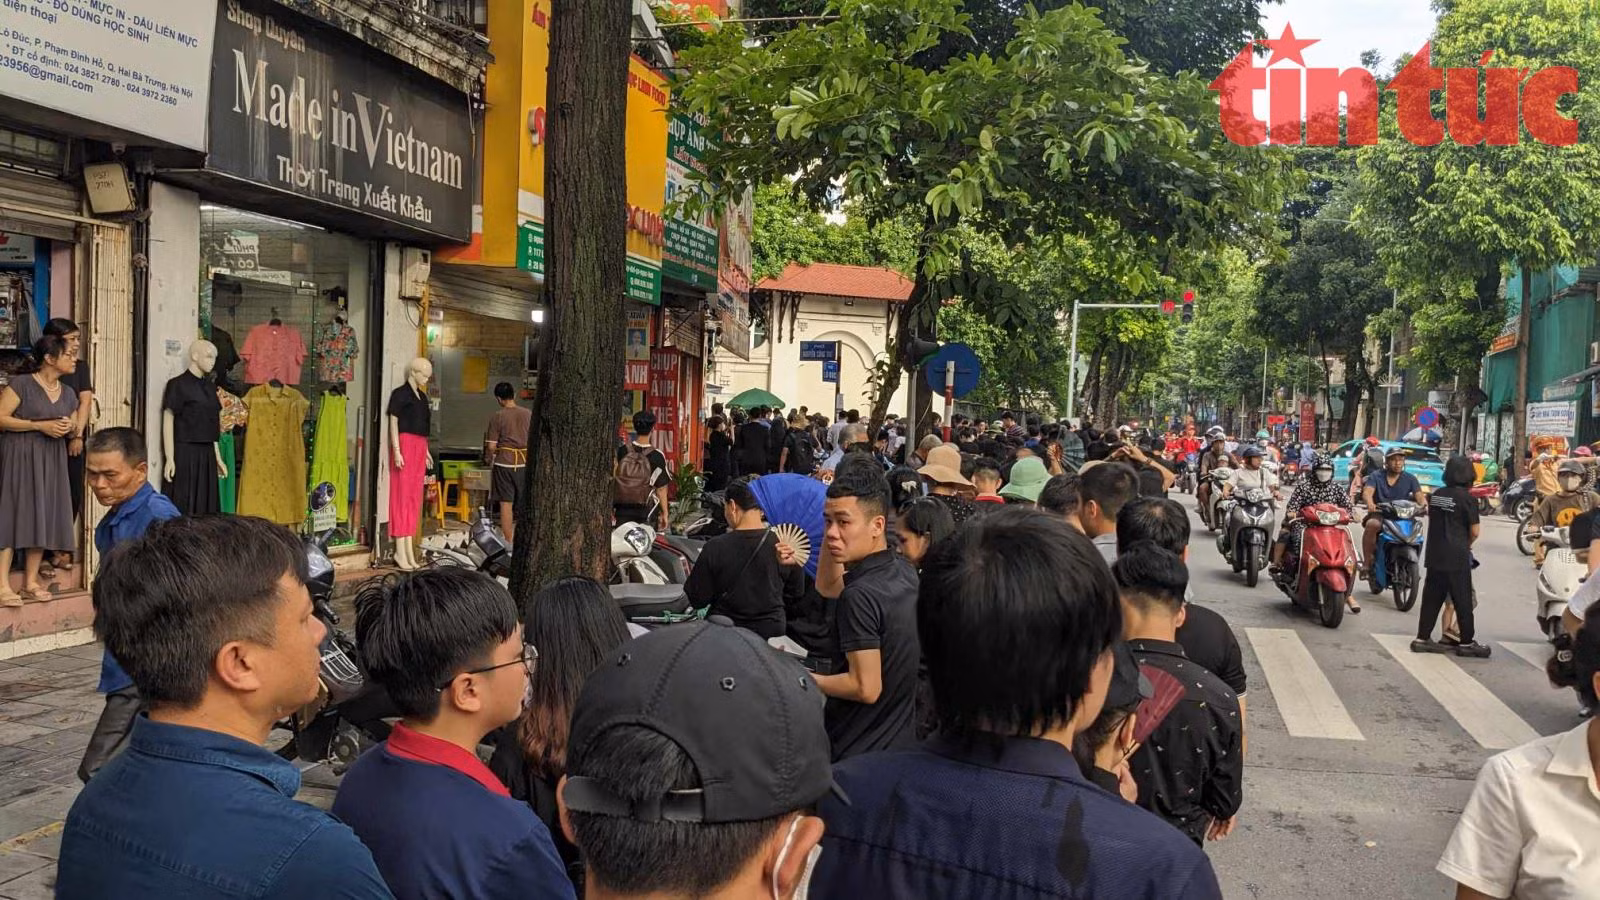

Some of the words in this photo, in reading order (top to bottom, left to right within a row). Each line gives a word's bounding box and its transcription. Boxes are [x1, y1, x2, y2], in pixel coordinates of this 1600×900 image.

[30, 5, 57, 25] thoại
[103, 17, 125, 34] HỌC
[127, 26, 150, 43] SINH
[115, 9, 126, 21] IN
[177, 32, 198, 48] MỰC
[226, 1, 262, 37] Shop
[12, 45, 26, 57] ĐT
[40, 55, 62, 70] định:
[64, 62, 79, 75] 024
[80, 67, 100, 81] 3821
[101, 74, 120, 88] 2780
[126, 82, 140, 95] 024
[142, 87, 160, 101] 3972
[34, 38, 43, 48] P.
[44, 41, 69, 56] Phạm
[107, 62, 116, 73] Q.
[118, 66, 131, 78] Hai
[132, 71, 143, 82] Bà
[170, 83, 180, 95] Hà
[181, 87, 194, 99] Nội
[232, 48, 323, 141] Made
[331, 89, 358, 153] in
[352, 91, 463, 190] Vietnam
[668, 117, 686, 142] HỤP
[276, 154, 316, 191] Thời
[363, 181, 397, 214] Xuất
[400, 193, 432, 224] Khẩu
[650, 352, 678, 375] CHỤP
[651, 373, 675, 397] ẢNH
[651, 400, 673, 424] THẺ
